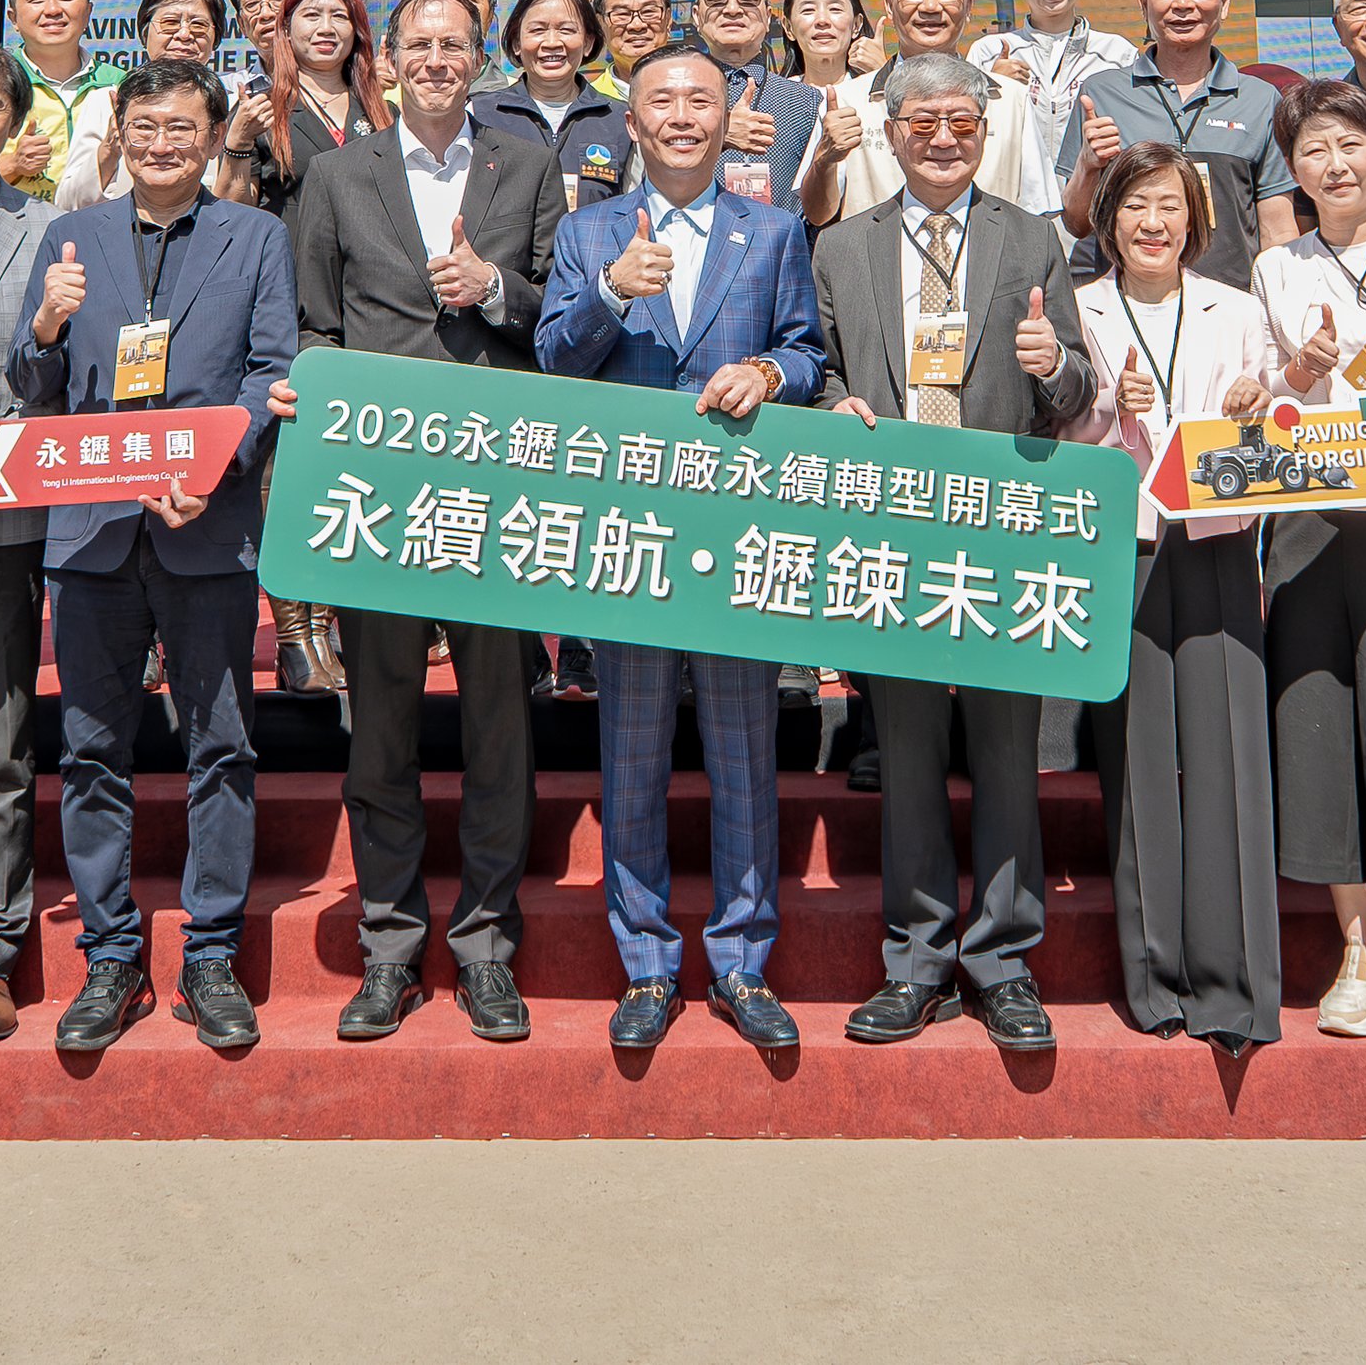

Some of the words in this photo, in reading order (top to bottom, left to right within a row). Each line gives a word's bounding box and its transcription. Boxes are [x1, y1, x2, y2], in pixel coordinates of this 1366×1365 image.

[42, 479, 61, 488] Yong
[69, 475, 116, 485] International
[117, 473, 160, 484] Engineering
[175, 471, 189, 479] Ltd.
